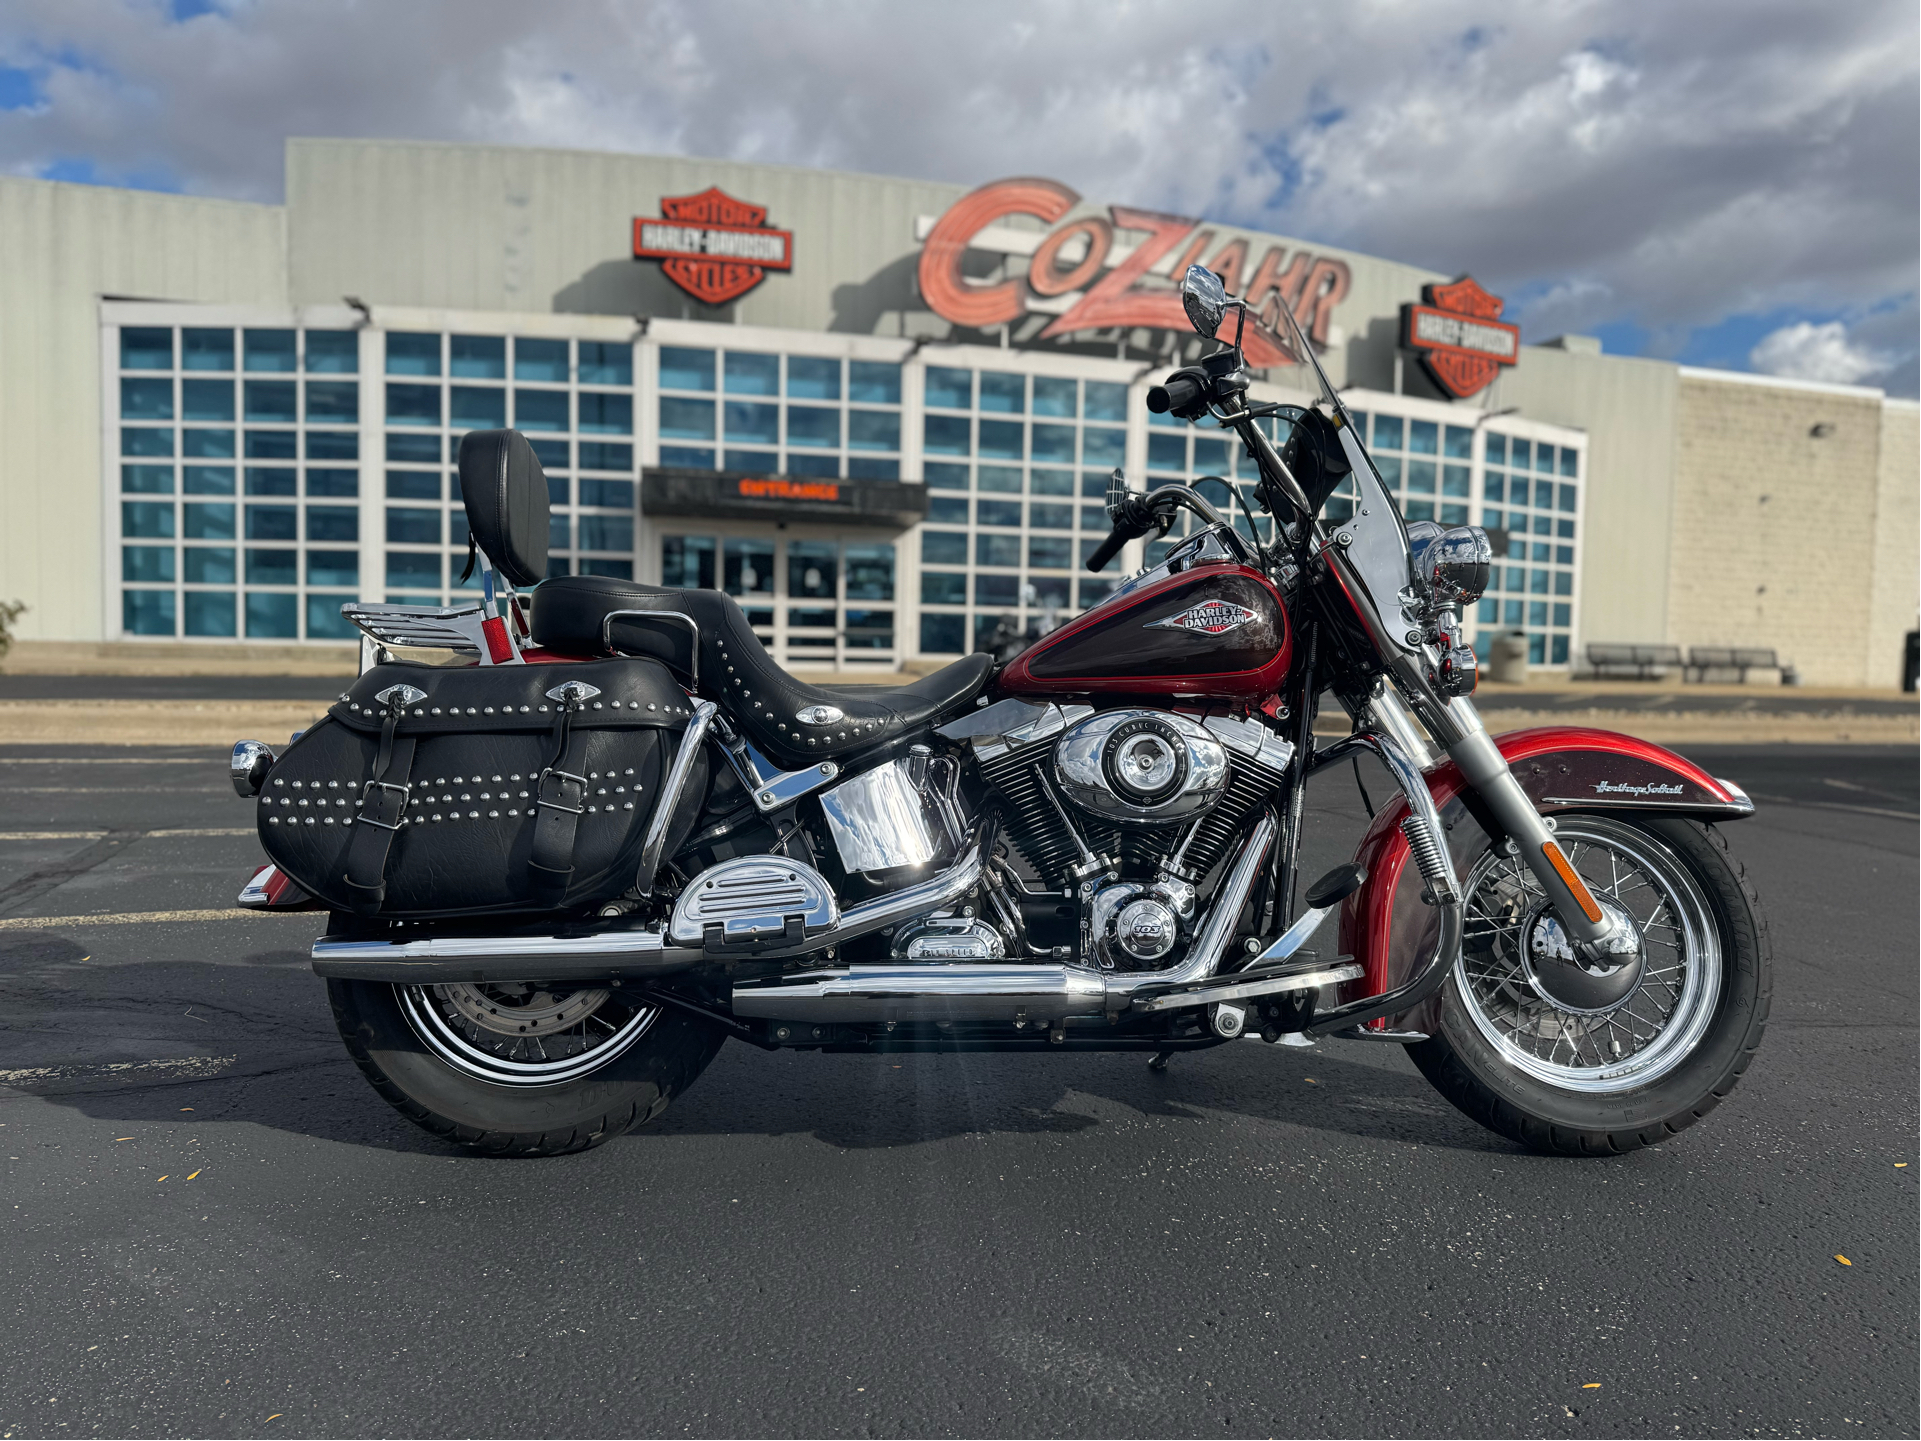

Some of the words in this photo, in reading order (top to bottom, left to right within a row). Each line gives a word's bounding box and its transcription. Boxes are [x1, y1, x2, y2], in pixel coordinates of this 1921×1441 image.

[641, 222, 784, 263] HARLEY-DAVIDSON
[1417, 311, 1514, 358] HARLEY-DAVIDSON
[738, 478, 839, 501] ENTRANCE
[1183, 614, 1246, 629] DAVIDSON
[1187, 606, 1243, 619] HARLEY-
[1119, 722, 1149, 737] CUBIC
[1154, 724, 1185, 754] INCHES
[1133, 925, 1161, 934] 103
[1483, 1060, 1526, 1096] ELITE
